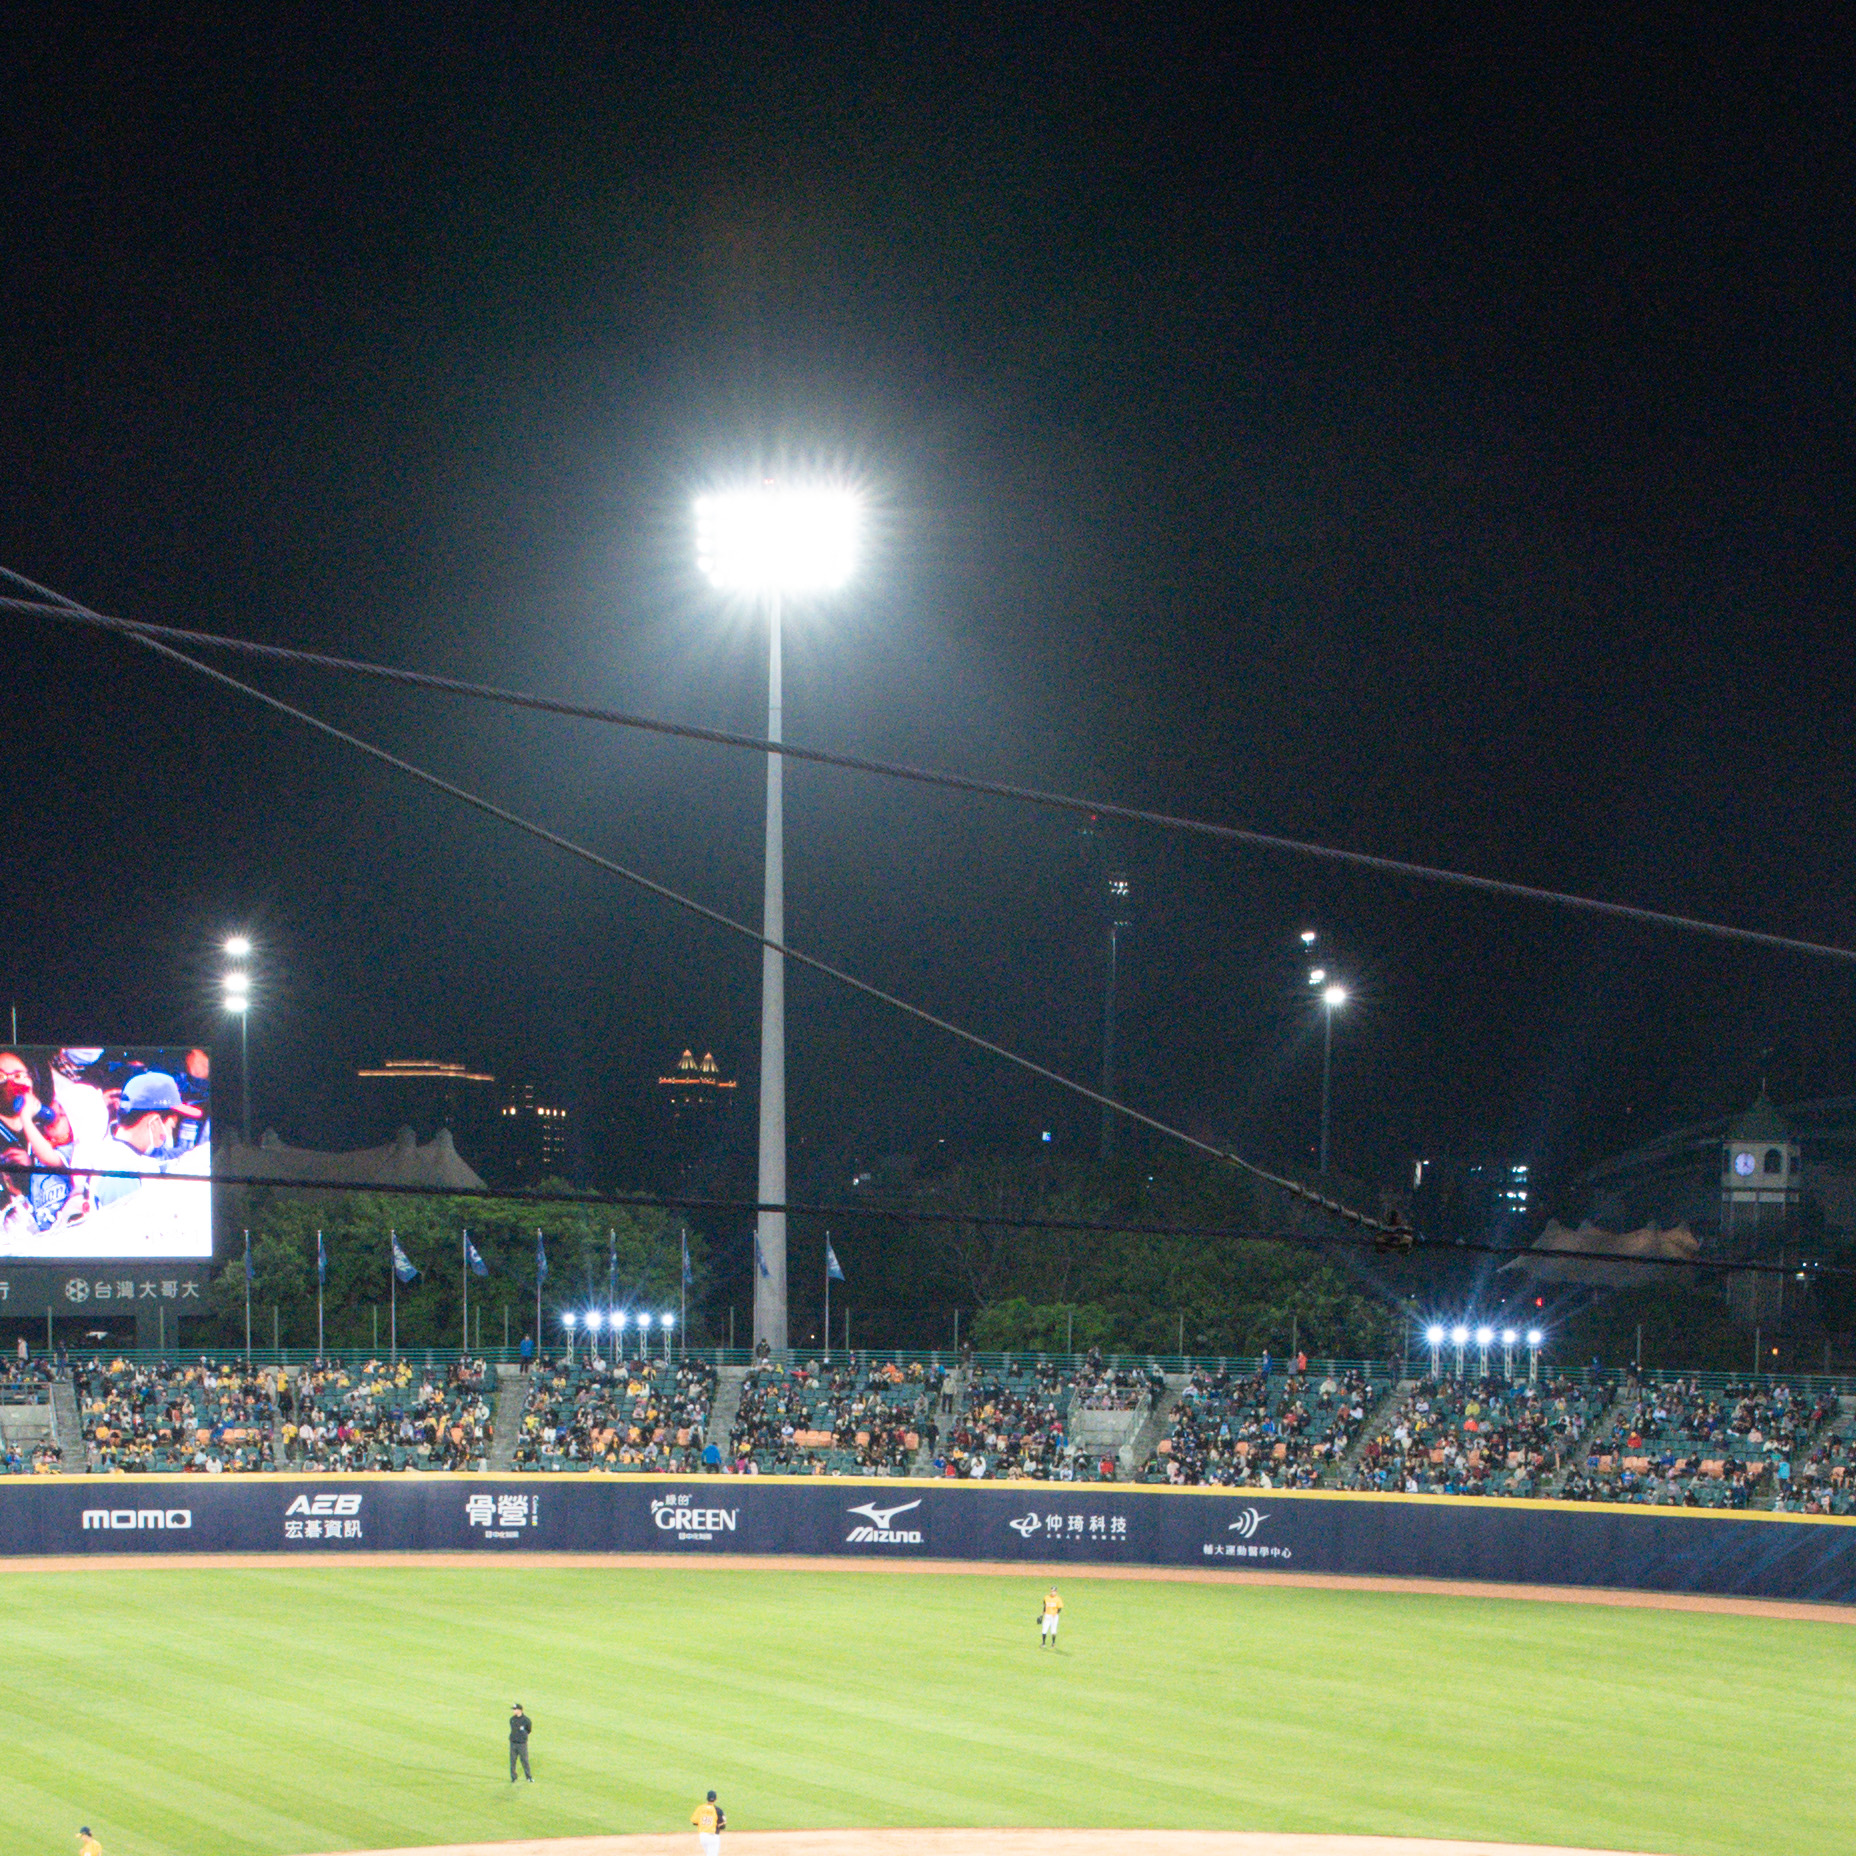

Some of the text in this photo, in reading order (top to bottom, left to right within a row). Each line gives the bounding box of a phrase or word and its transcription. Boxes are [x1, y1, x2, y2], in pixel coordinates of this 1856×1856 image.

[95, 1280, 199, 1299] 台灣大哥大
[285, 1494, 363, 1516] AEB
[465, 1494, 529, 1527] 骨營
[655, 1507, 736, 1531] GREEN
[1045, 1514, 1127, 1533] 仲琦科技
[285, 1520, 363, 1538] 宏碁資訊
[846, 1526, 922, 1544] MIZUNO
